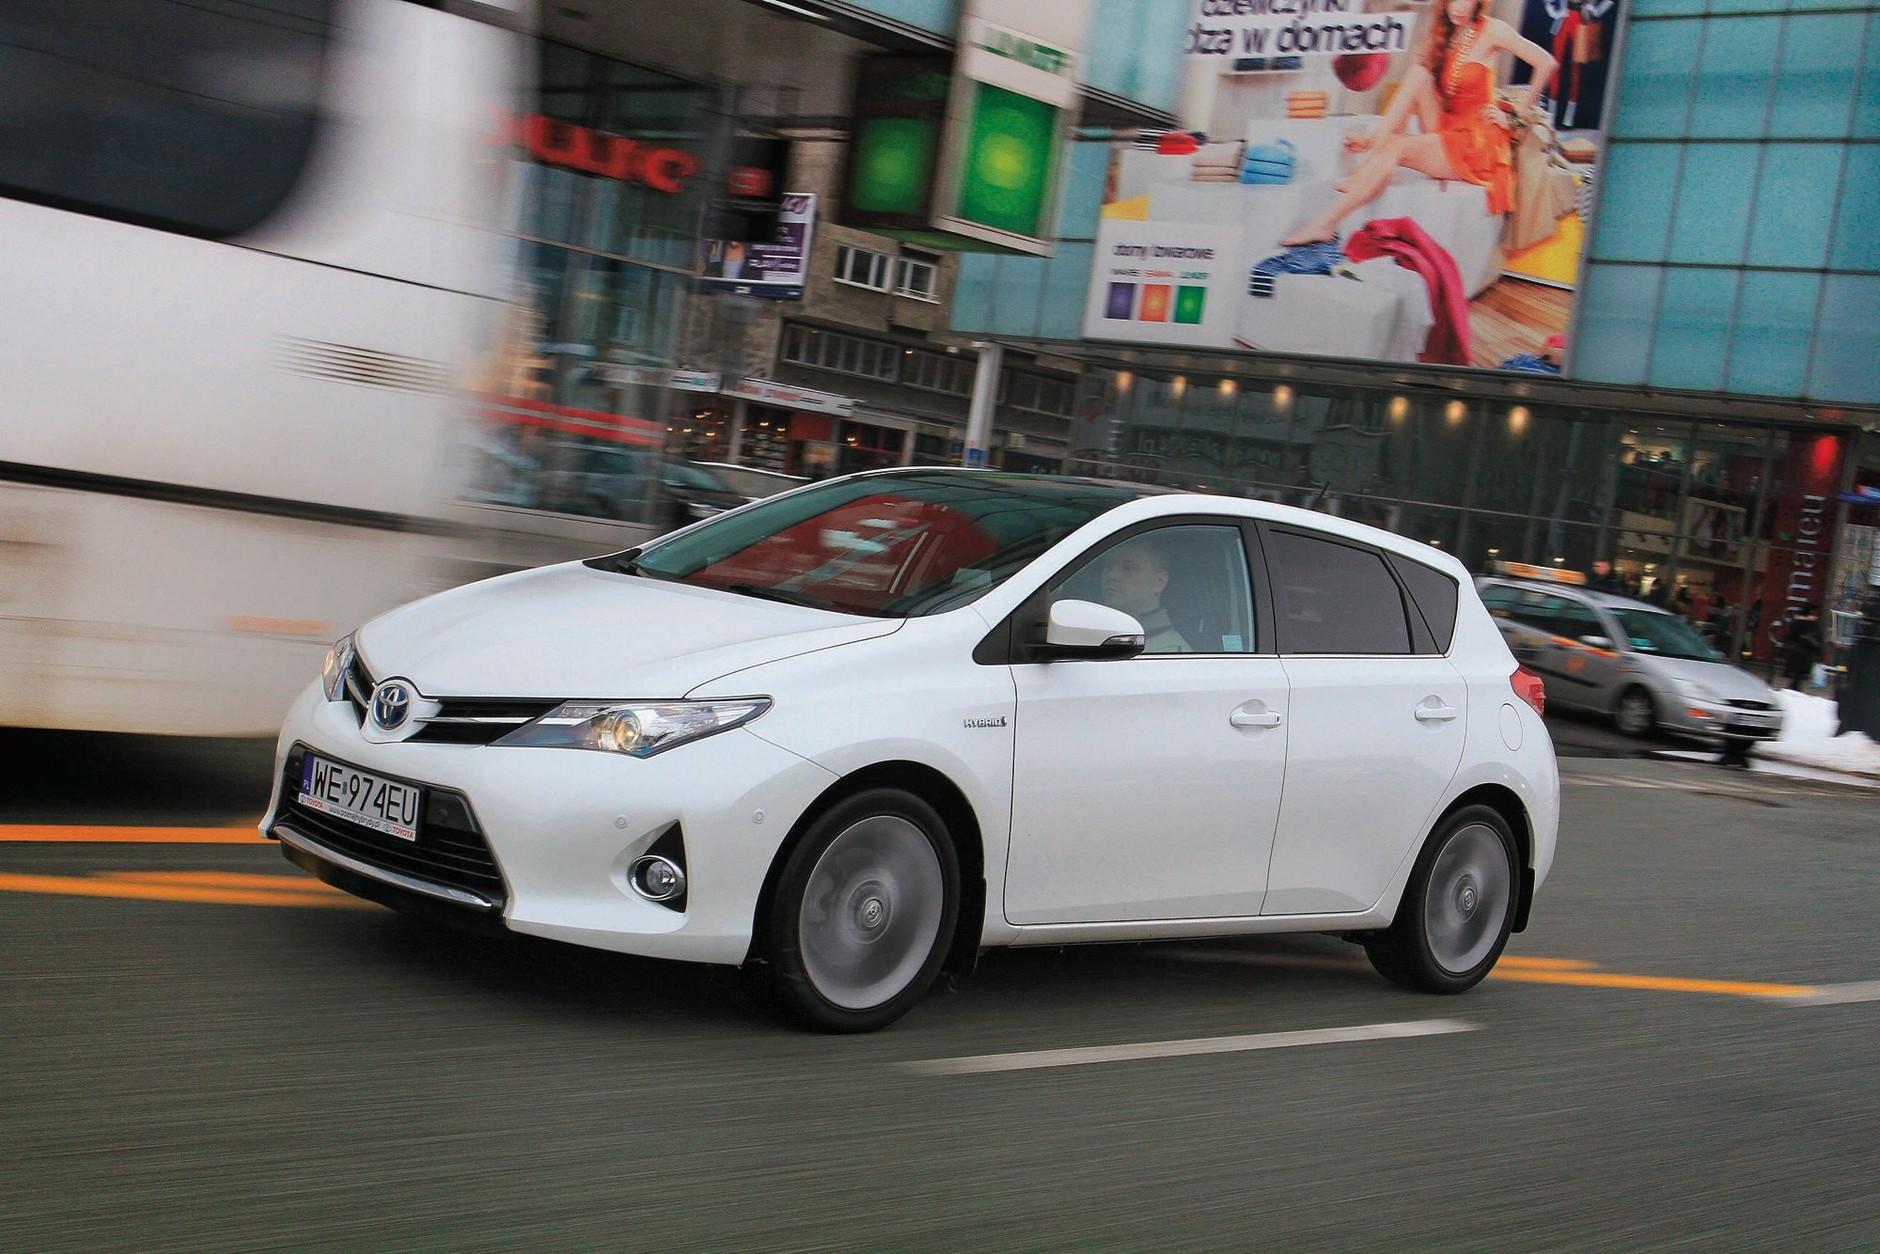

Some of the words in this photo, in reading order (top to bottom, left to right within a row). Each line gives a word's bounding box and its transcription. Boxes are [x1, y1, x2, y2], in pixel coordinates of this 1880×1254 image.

[1243, 28, 1271, 53] w
[1277, 16, 1404, 51] domach
[964, 718, 1002, 728] HYBRID
[313, 761, 342, 803] WE
[348, 774, 417, 825] 974EU
[305, 797, 324, 810] TOYOTA
[392, 826, 414, 839] TOYOTA
